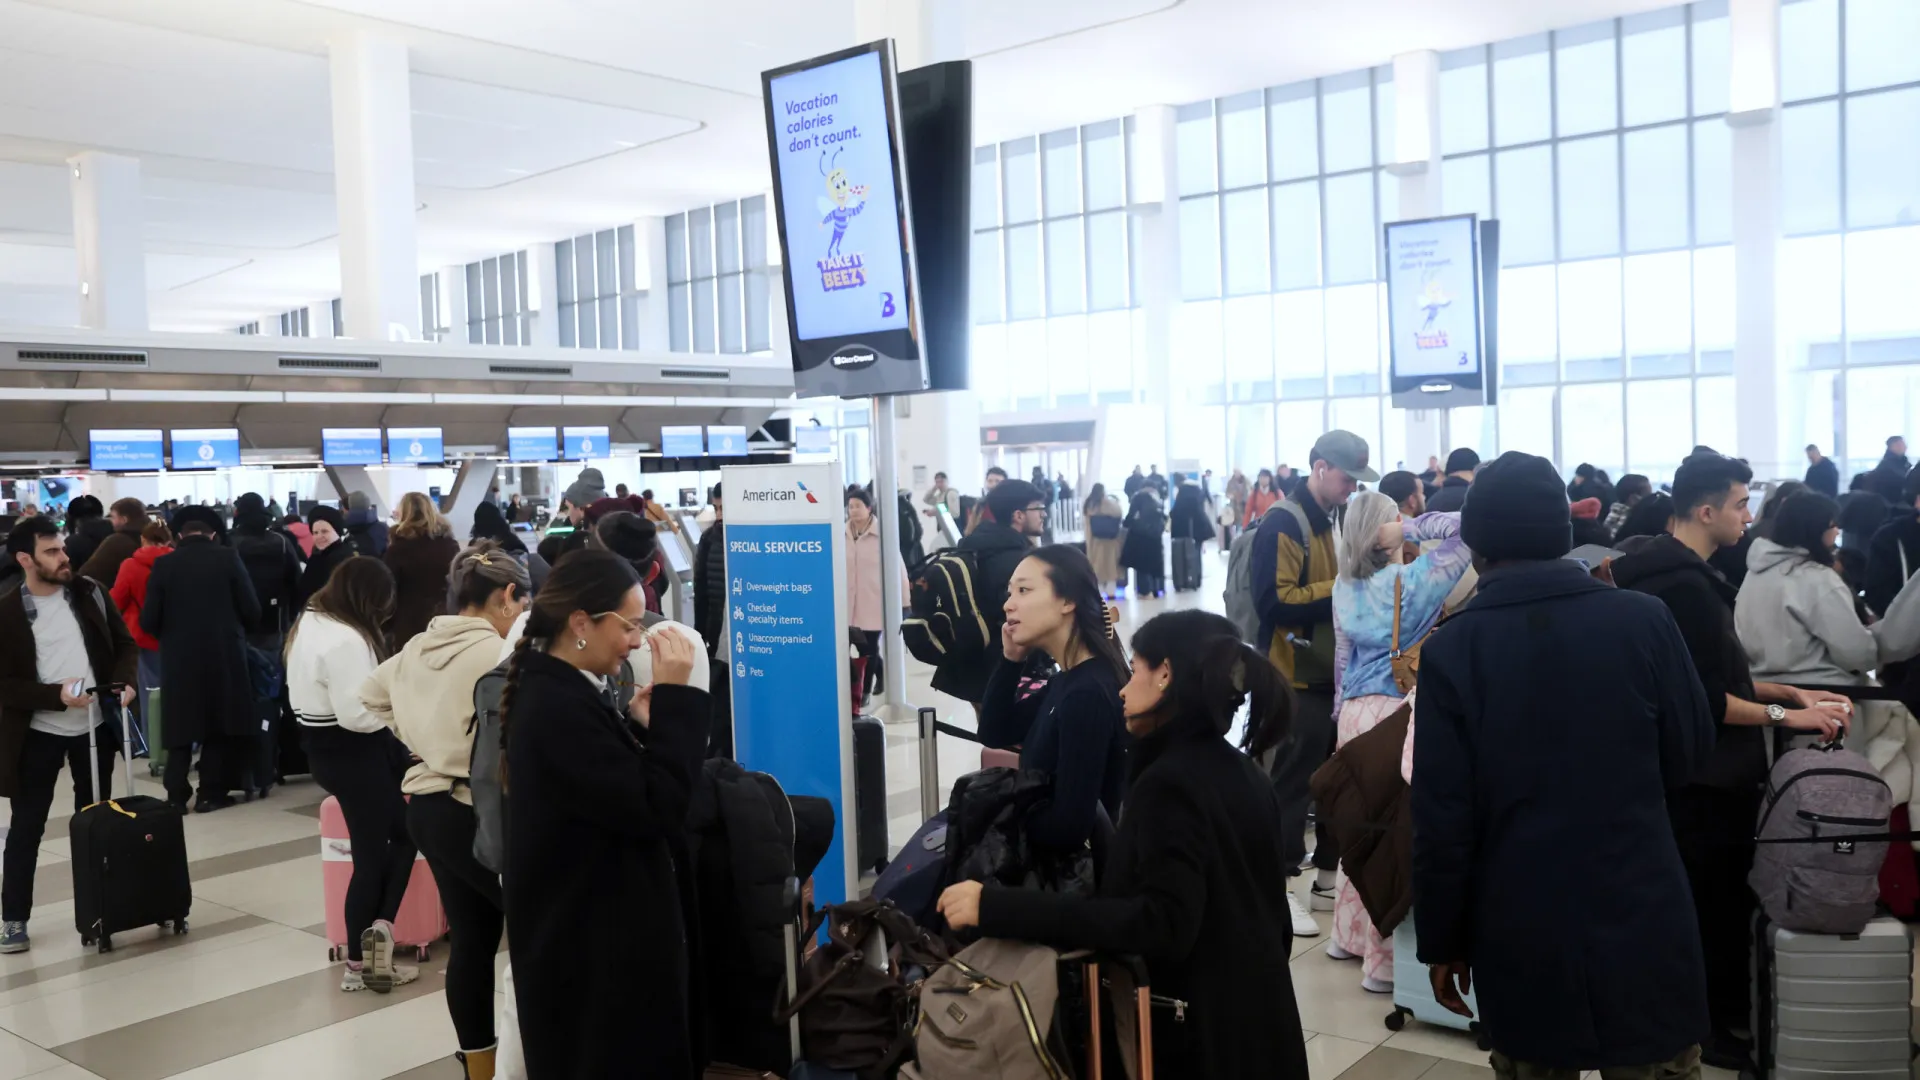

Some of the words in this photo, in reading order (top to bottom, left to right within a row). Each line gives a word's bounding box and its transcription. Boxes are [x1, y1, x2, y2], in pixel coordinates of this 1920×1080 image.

[785, 93, 838, 115] Vacation
[787, 112, 833, 134] calories
[789, 133, 819, 152] don't
[822, 125, 861, 145] count.
[819, 254, 852, 271] TAKE
[852, 252, 865, 266] IT
[822, 268, 867, 290] BEEZY
[880, 292, 896, 318] B
[742, 488, 796, 501] American
[730, 541, 762, 553] SPECIAL
[764, 541, 822, 553] SERVICES
[746, 582, 790, 595] Overweight
[791, 582, 813, 594] bags
[747, 602, 777, 613] Checked
[747, 615, 778, 627] specialty
[779, 616, 804, 625] items
[748, 633, 813, 645] Unaccompanied
[749, 644, 773, 655] minors
[750, 667, 764, 677] Pets
